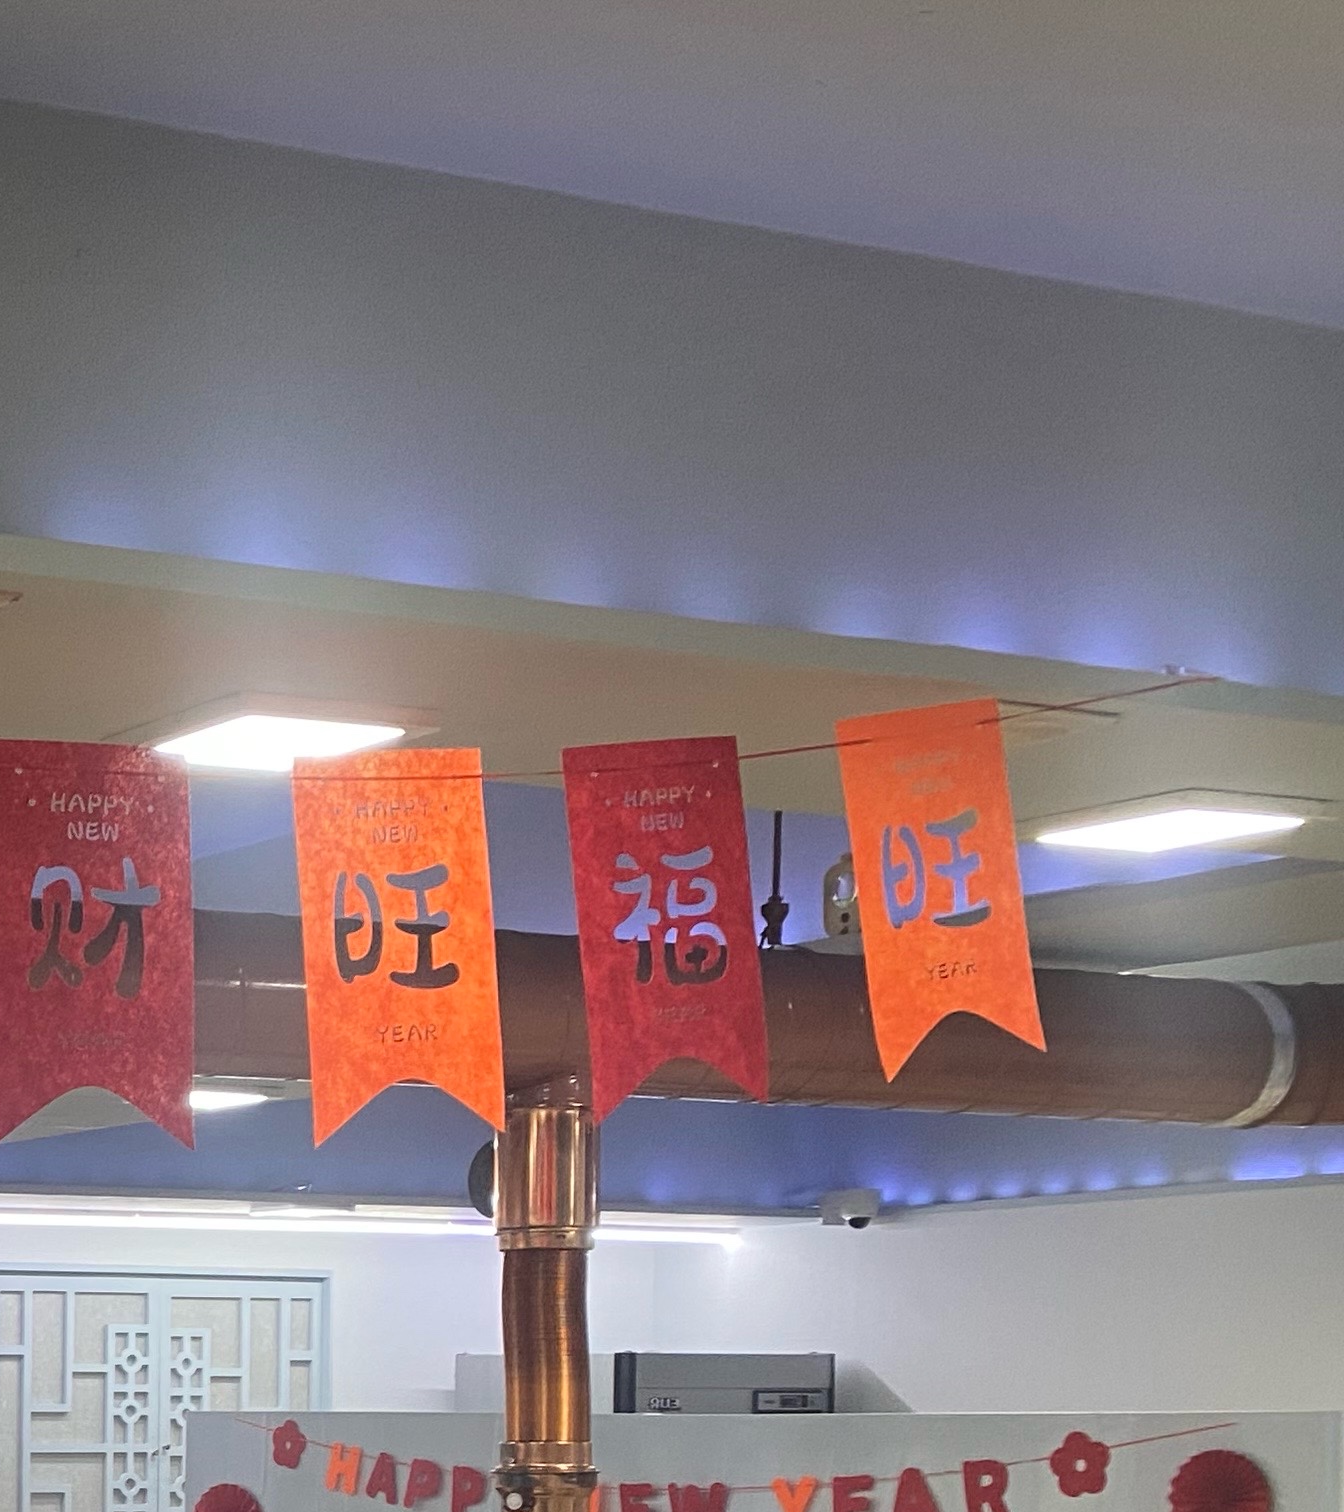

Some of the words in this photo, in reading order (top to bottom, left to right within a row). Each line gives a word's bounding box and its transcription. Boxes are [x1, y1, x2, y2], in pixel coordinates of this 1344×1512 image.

[49, 792, 134, 816] HAPPY
[622, 785, 696, 809] HAPPY
[354, 798, 432, 821] HAPPY
[66, 821, 121, 843] NEW
[639, 812, 685, 832] NEW
[371, 825, 419, 844] NEW
[880, 807, 993, 930] 旺
[27, 856, 161, 998] 财
[334, 863, 460, 989] 旺
[611, 845, 729, 986] 福
[376, 1023, 438, 1043] YEAR
